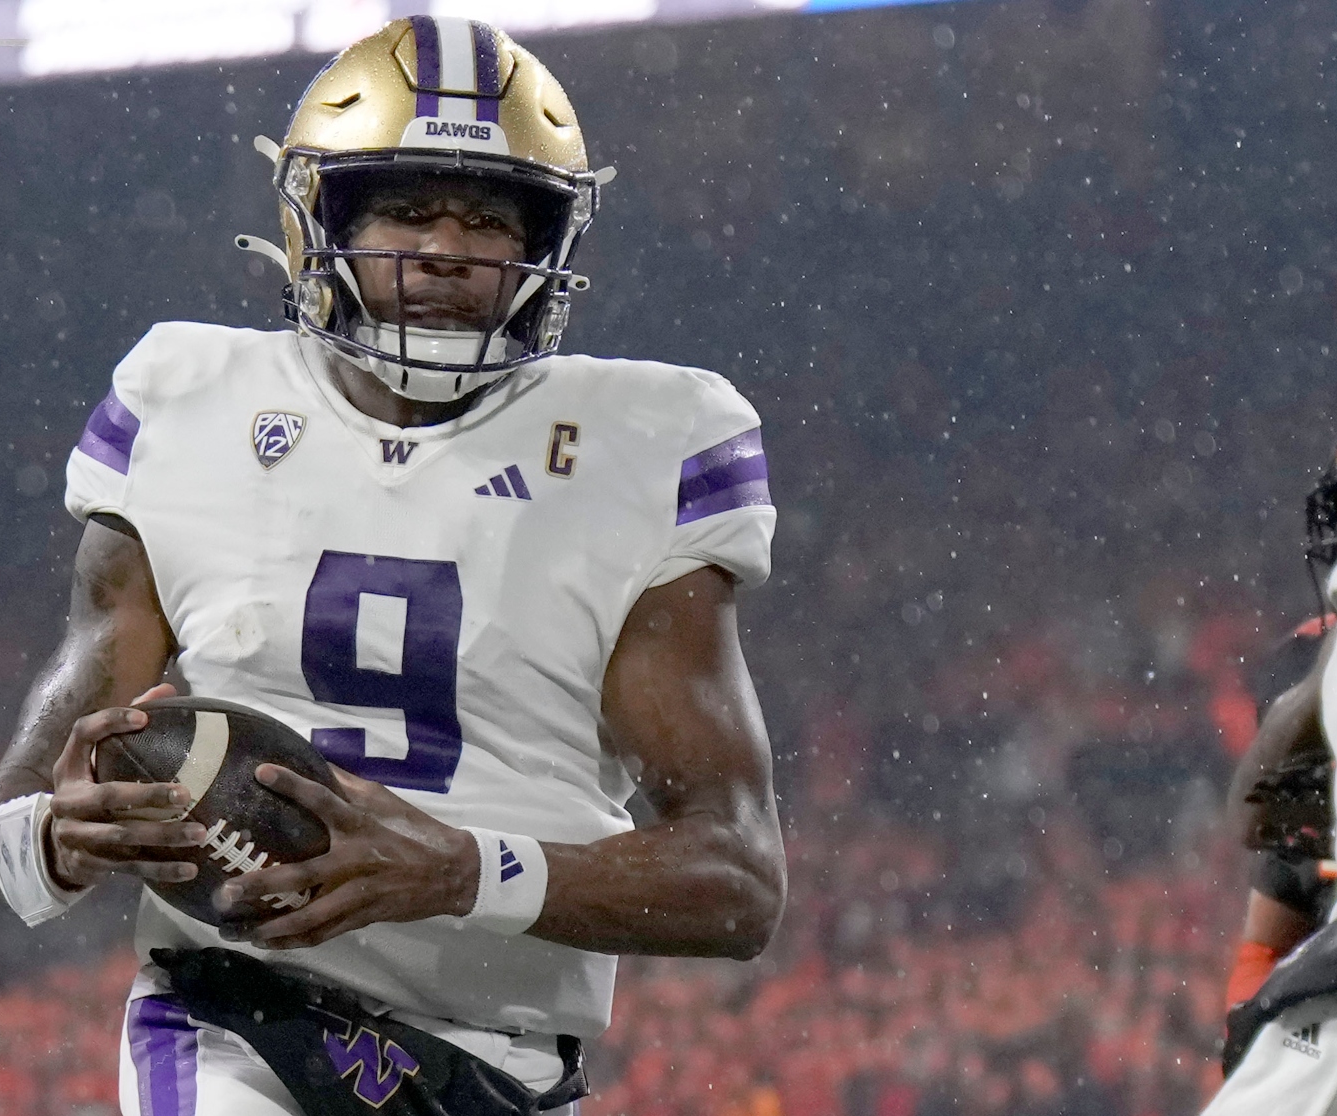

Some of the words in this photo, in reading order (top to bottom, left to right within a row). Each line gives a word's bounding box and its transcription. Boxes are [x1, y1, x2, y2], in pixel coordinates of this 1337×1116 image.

[425, 121, 491, 140] DAWGS
[254, 413, 303, 447] PAC
[259, 436, 287, 457] 12
[379, 438, 419, 465] W
[545, 420, 581, 480] C
[300, 549, 464, 795] 9
[1282, 1036, 1323, 1060] adidas
